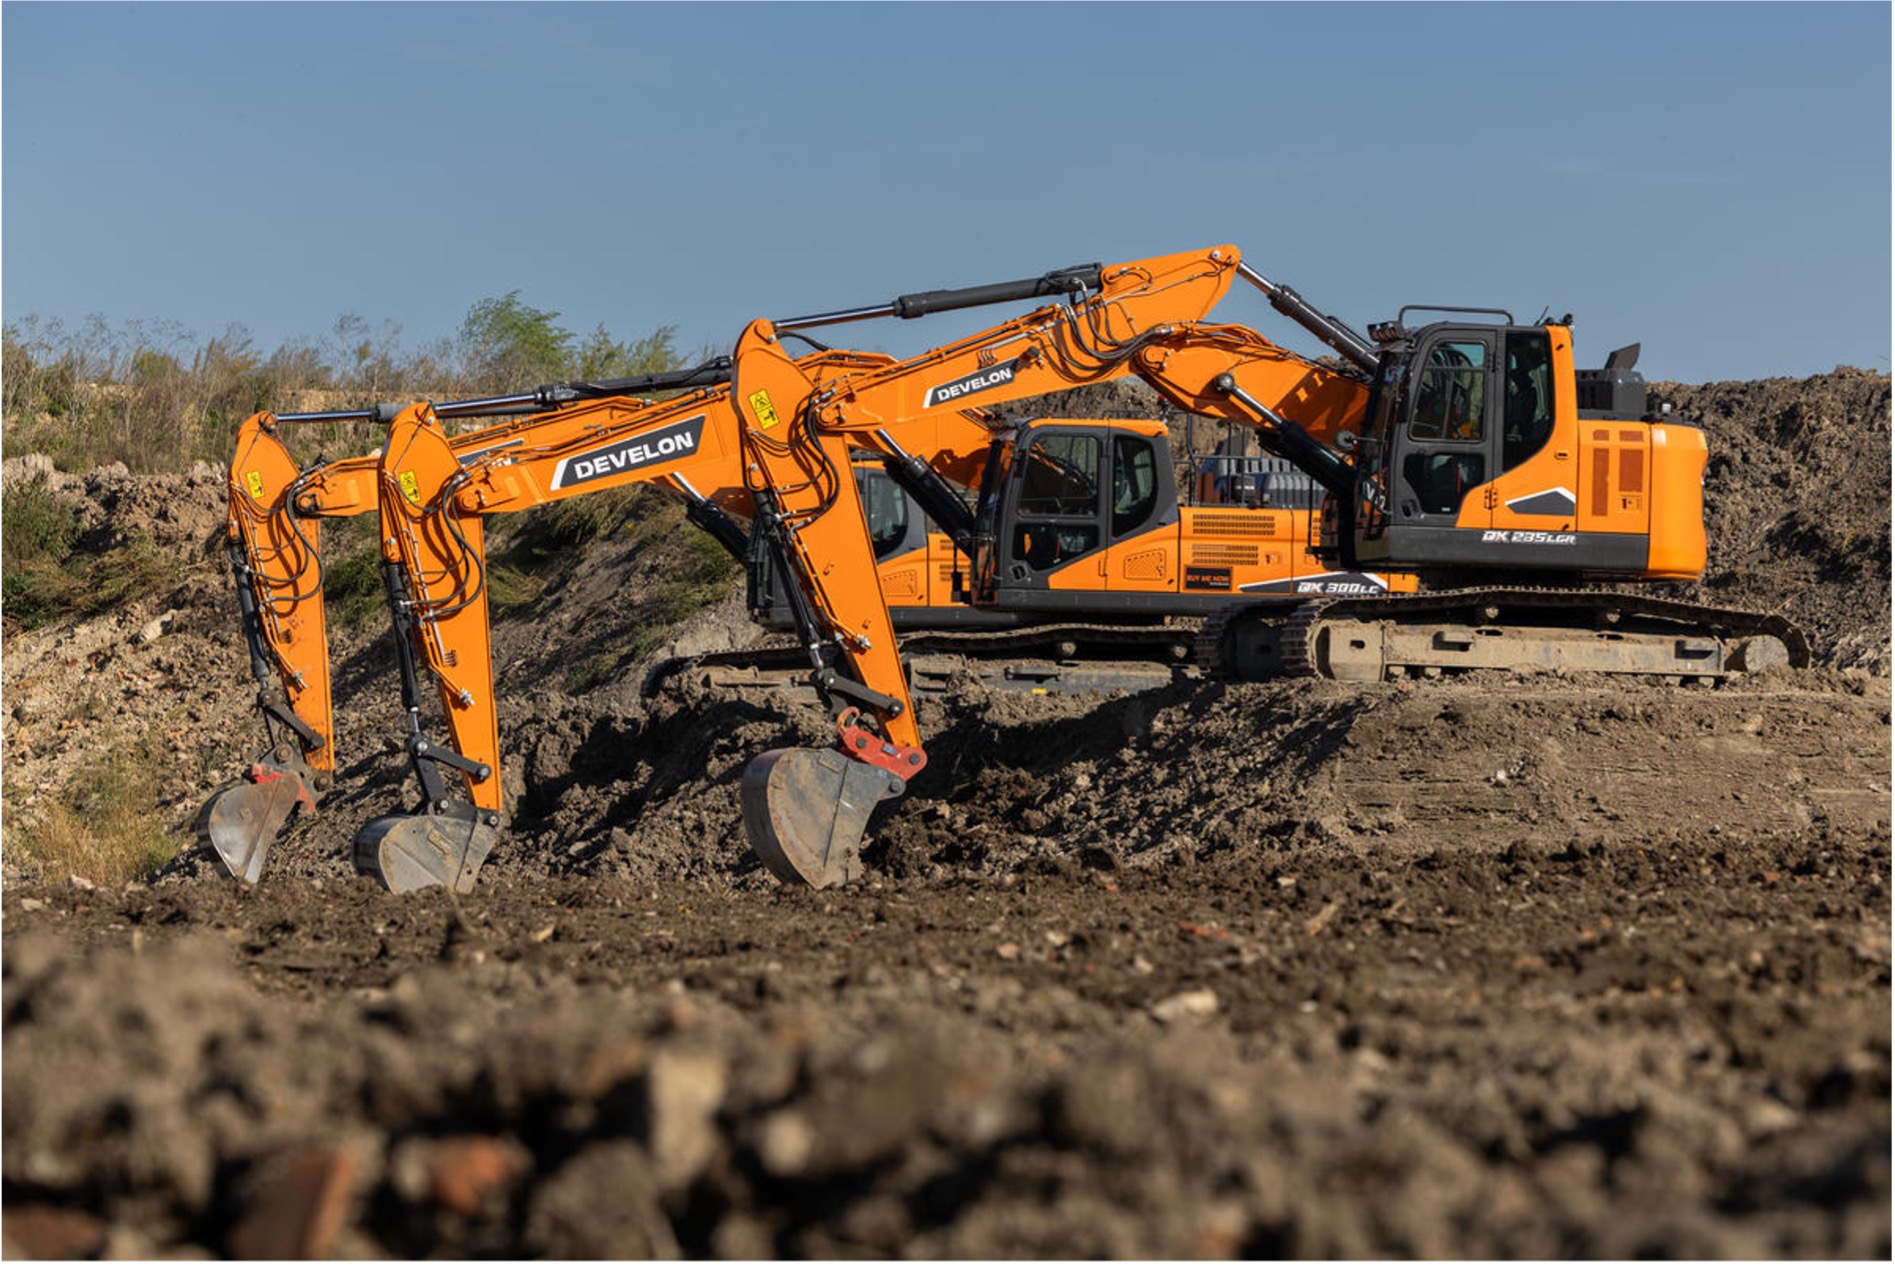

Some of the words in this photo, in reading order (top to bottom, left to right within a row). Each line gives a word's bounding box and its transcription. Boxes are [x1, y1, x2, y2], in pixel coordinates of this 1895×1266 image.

[937, 367, 1012, 401] DEVELON
[574, 431, 694, 479] DEVELON
[1325, 582, 1379, 594] 300LC
